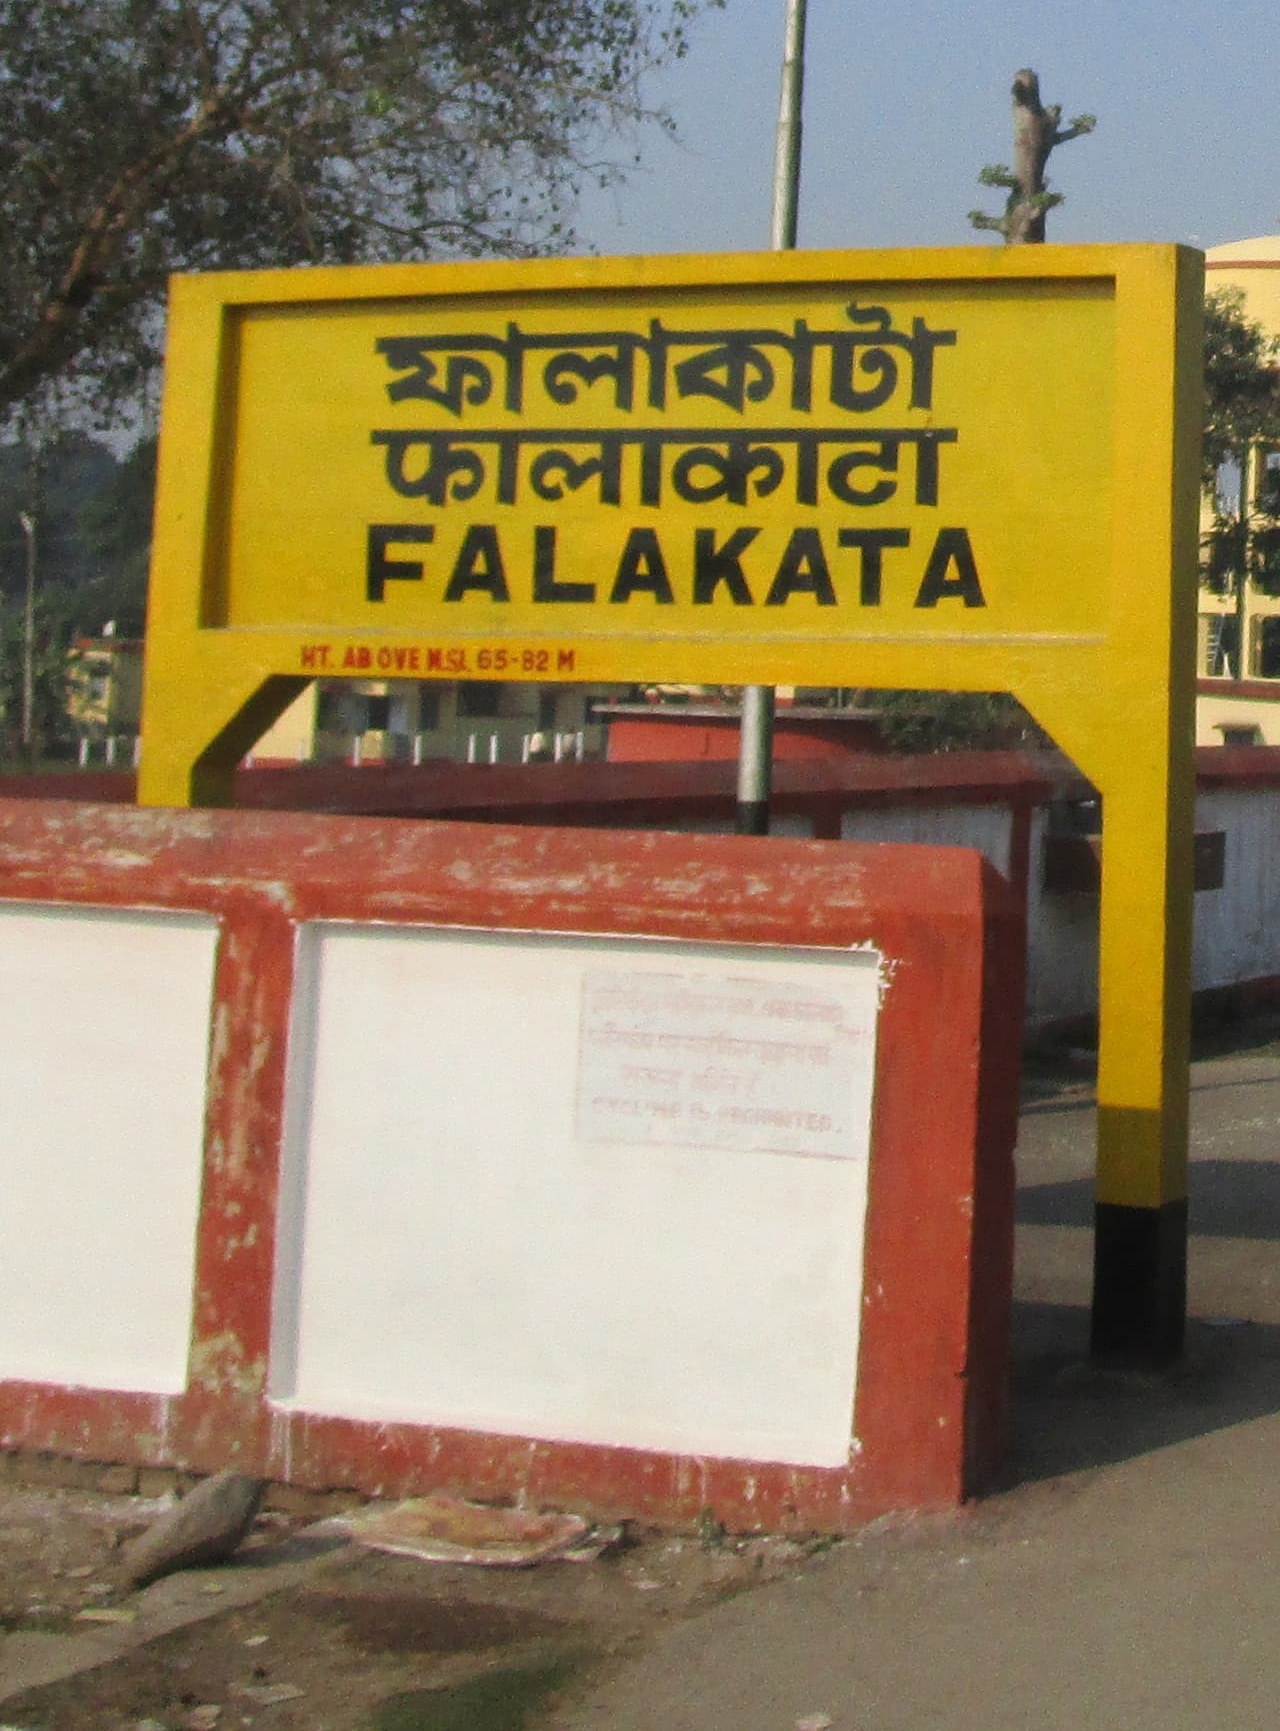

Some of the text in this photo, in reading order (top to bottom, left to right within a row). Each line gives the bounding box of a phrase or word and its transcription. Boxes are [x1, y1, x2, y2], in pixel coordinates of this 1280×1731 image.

[375, 303, 958, 415] ফালাকাটা
[370, 427, 958, 508] फालाकाटा
[366, 524, 985, 608] FALAKATA
[558, 649, 576, 671] M
